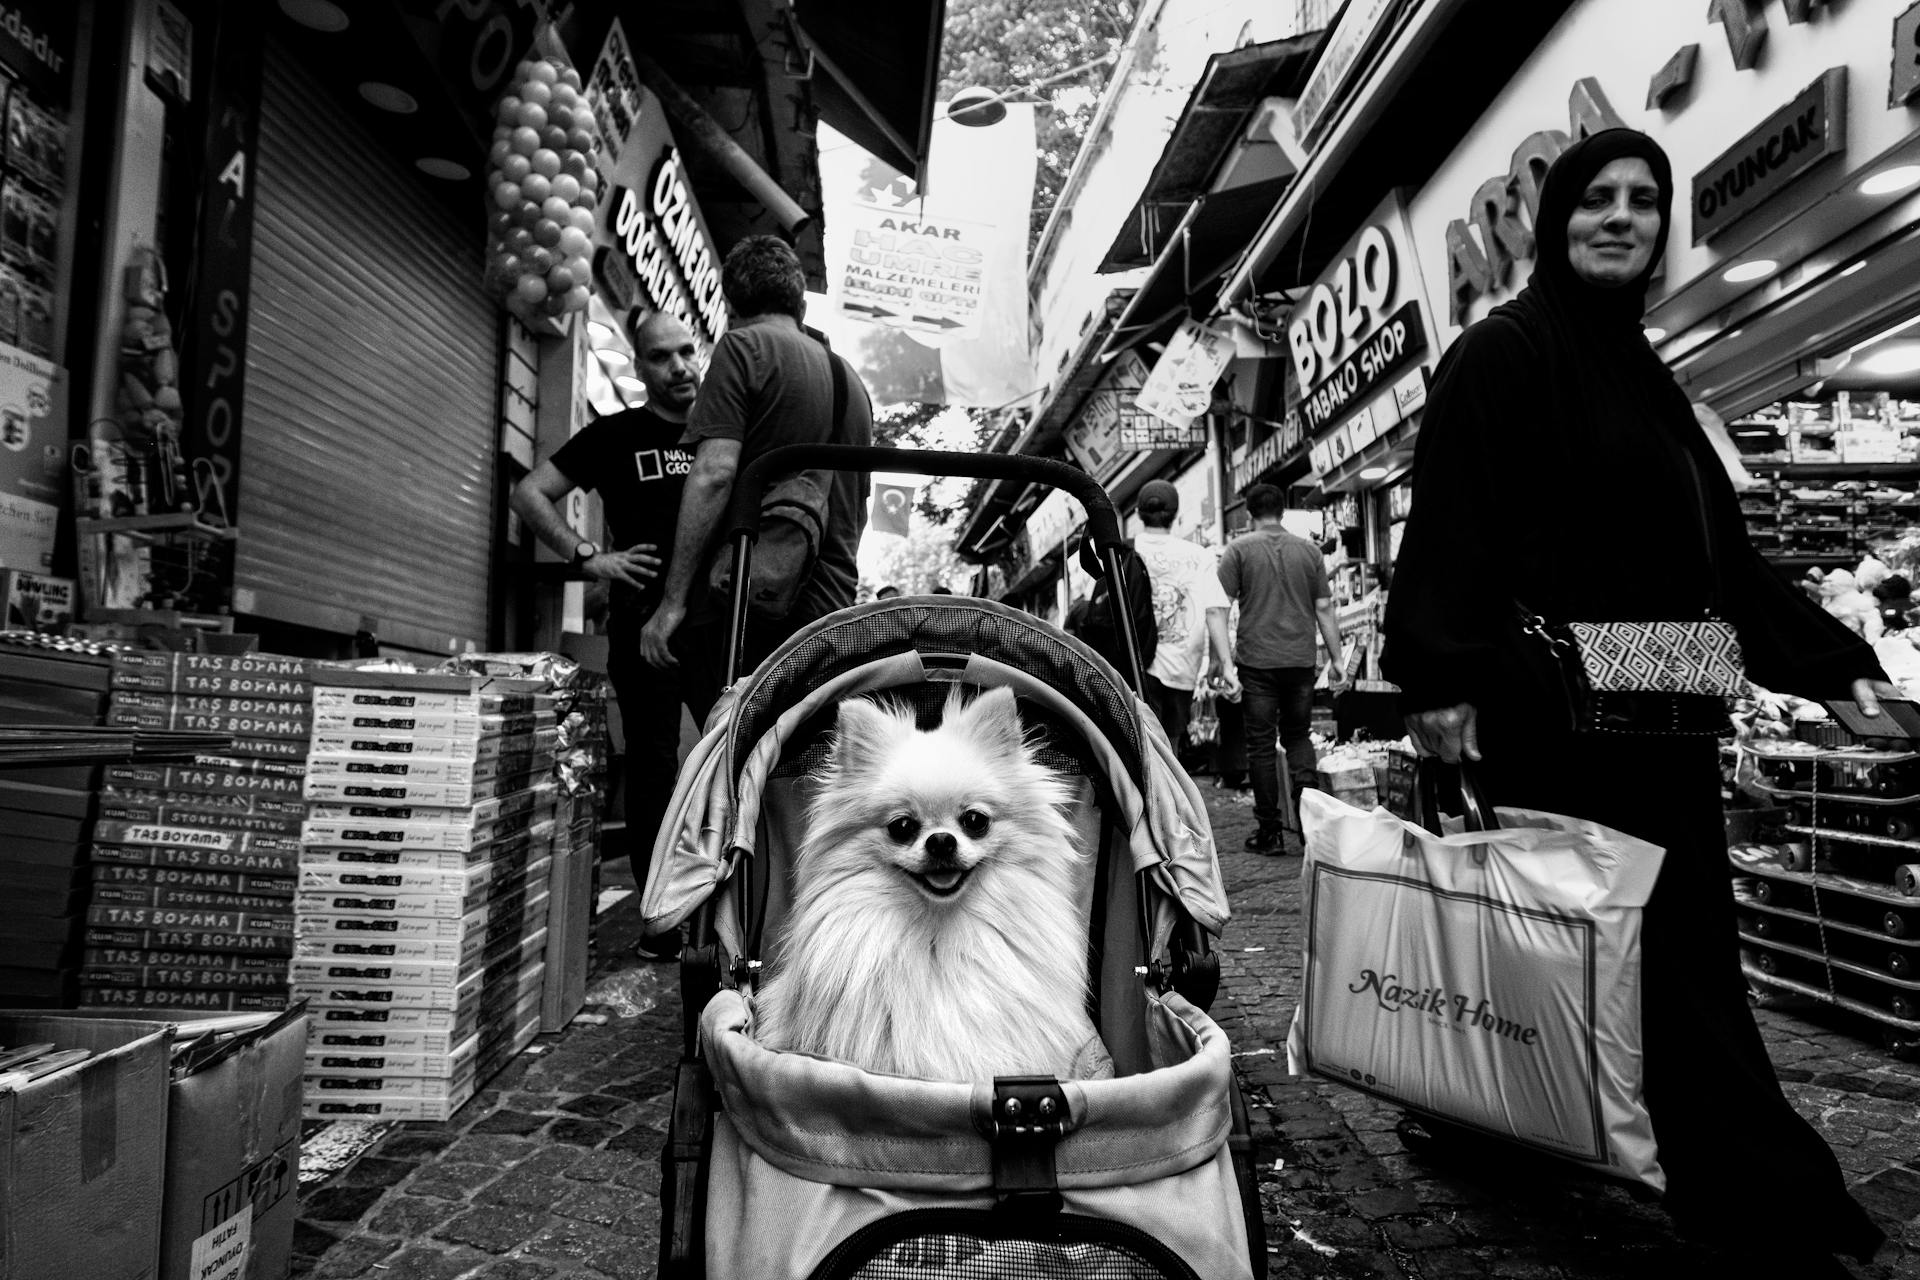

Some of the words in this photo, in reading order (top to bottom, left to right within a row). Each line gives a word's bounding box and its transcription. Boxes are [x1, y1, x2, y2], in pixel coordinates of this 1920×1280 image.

[1699, 105, 1820, 219] OYUNCAK
[880, 218, 961, 241] AKAR
[854, 229, 983, 264] HAC
[1289, 226, 1392, 399] BOZO
[1304, 361, 1357, 430] TABAKO
[1360, 320, 1405, 382] SHOP
[666, 462, 691, 475] GEO
[16, 579, 69, 598] BOWLING
[231, 658, 304, 675] BOYAMA
[229, 678, 304, 695] BOYAMA
[229, 699, 303, 715] BOYAMA
[228, 718, 304, 734] BOYAMA
[223, 774, 298, 791] BOYAMA
[220, 817, 286, 830] PAINTING
[162, 830, 222, 844] BOYAMA
[208, 853, 283, 868] BOYAMA
[155, 869, 230, 885] BOYAMA
[152, 912, 230, 927] BOYAMA
[201, 934, 276, 948] BOYAMA
[148, 952, 224, 966] BOYAMA
[201, 971, 276, 985] BOYAMA
[144, 991, 221, 1005] BOYAMA
[1349, 969, 1448, 1017] Nazik
[1453, 995, 1538, 1046] Home
[200, 1241, 243, 1280] OYUNCAK
